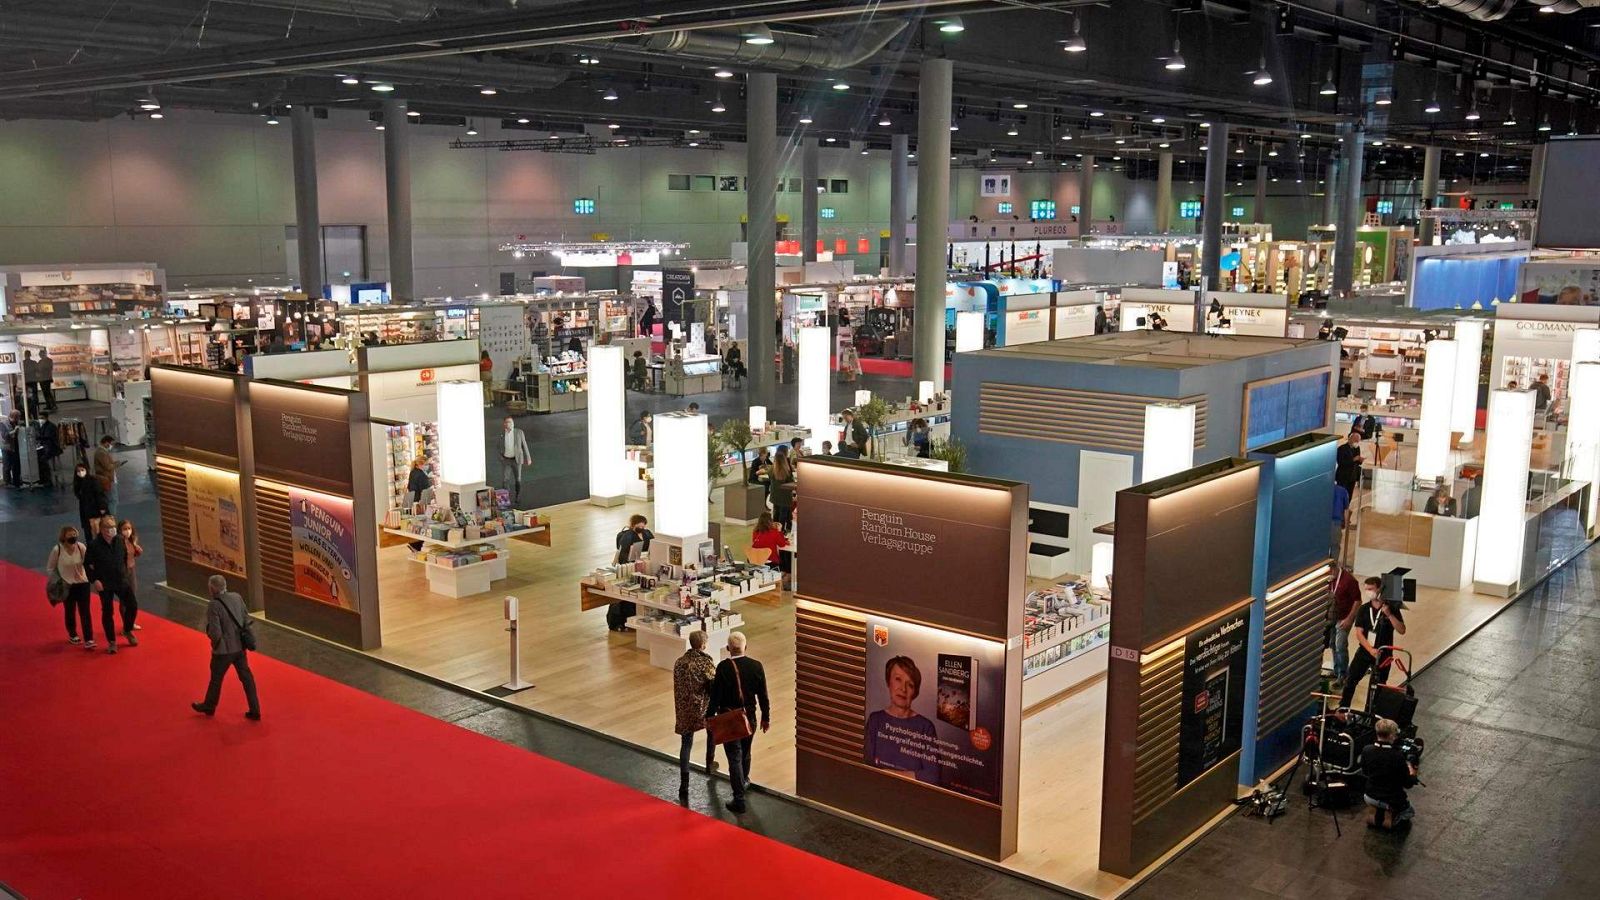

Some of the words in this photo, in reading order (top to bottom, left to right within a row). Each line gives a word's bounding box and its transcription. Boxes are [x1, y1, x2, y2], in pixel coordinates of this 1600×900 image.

[1228, 308, 1256, 317] HEYNE
[1516, 321, 1575, 332] GOLDMANN
[310, 503, 344, 537] PENGUIN
[861, 508, 903, 525] Penguin
[304, 516, 332, 541] JUNIOR
[861, 520, 903, 537] Random
[903, 527, 936, 543] House
[861, 531, 933, 555] Verlagsgruppe
[1116, 648, 1122, 656] D
[1126, 649, 1135, 659] 15
[938, 666, 970, 679] SANDBERG
[944, 659, 963, 669] ELLEN
[885, 722, 932, 742] Psychologische
[878, 731, 889, 740] Eine
[889, 734, 926, 750] ergreifende
[926, 743, 985, 767] Familiengeschichte.
[900, 747, 937, 764] Meisterhaft
[938, 758, 958, 770] erzählt.
